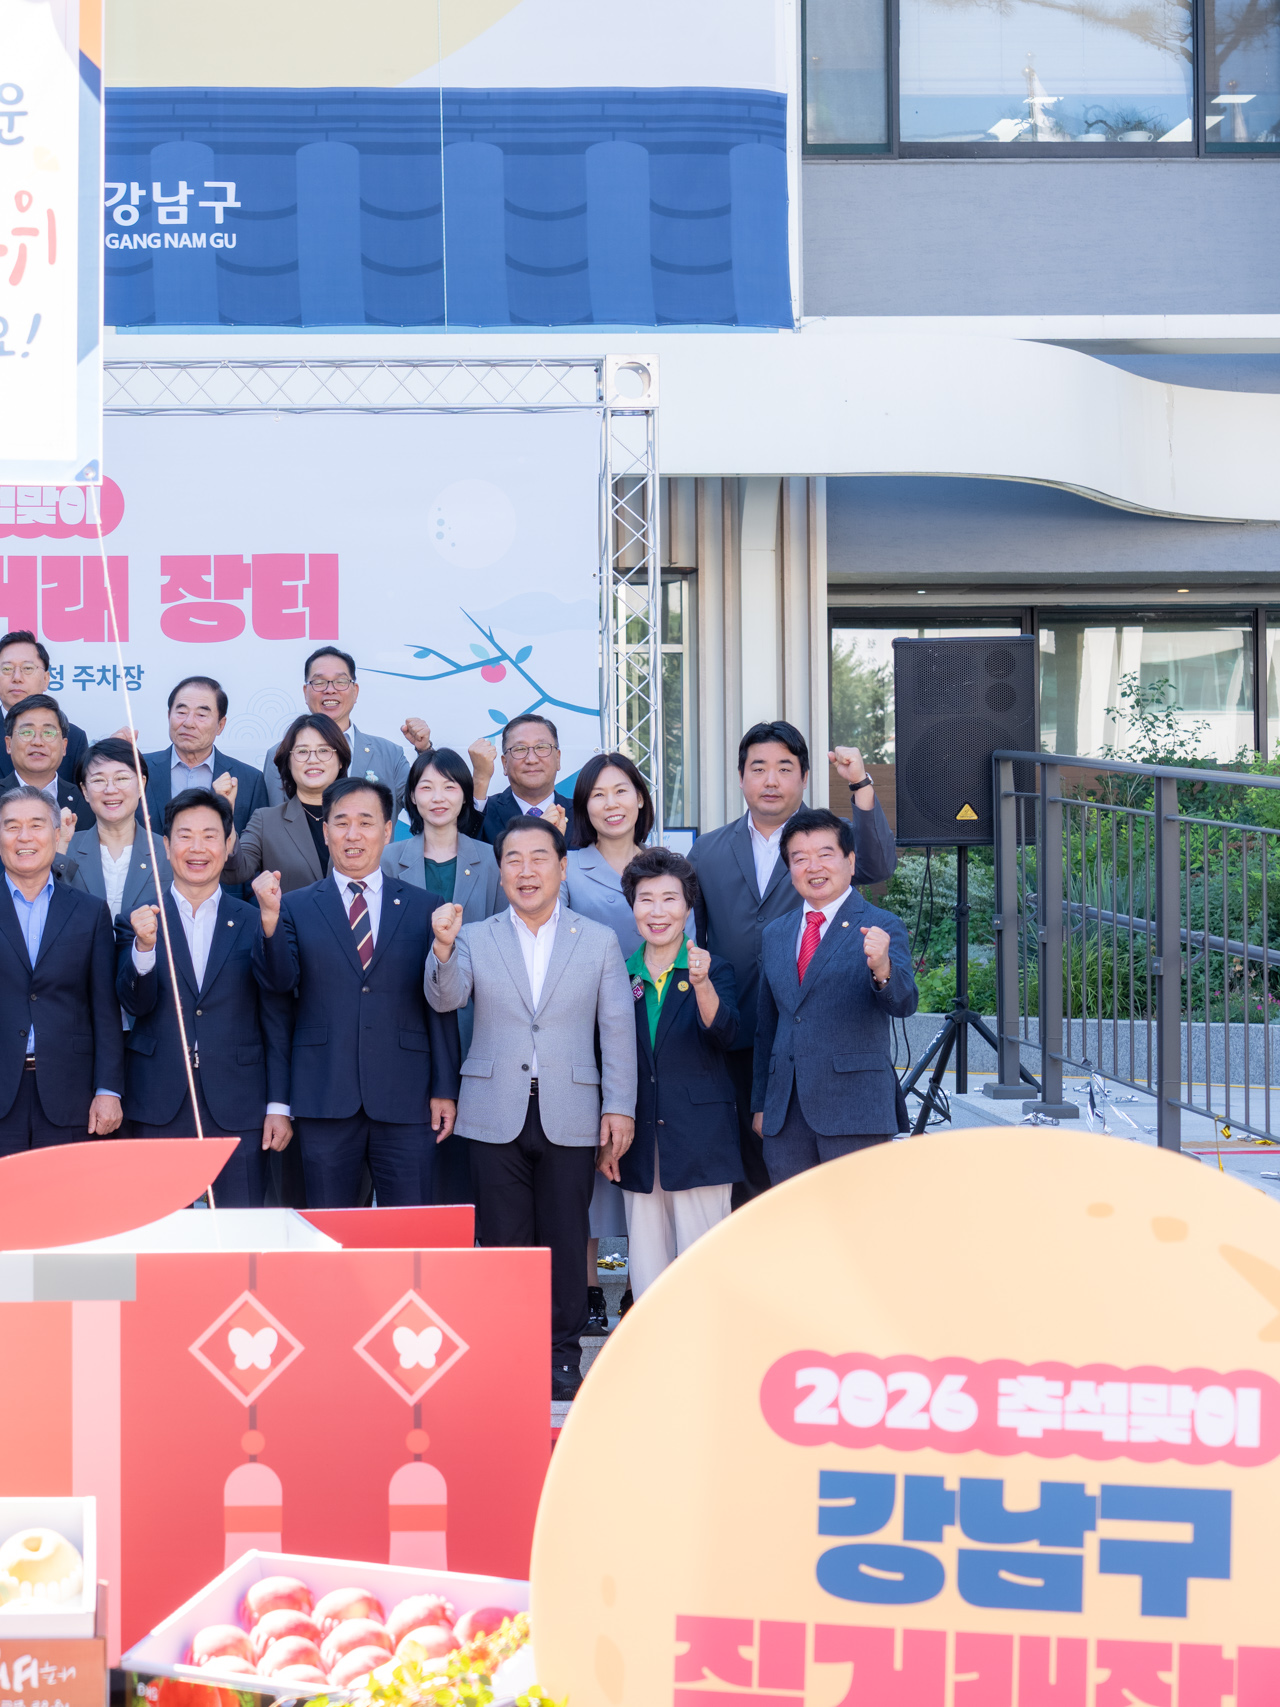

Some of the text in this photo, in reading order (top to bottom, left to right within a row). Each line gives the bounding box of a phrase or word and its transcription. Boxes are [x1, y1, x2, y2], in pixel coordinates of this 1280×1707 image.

[105, 181, 241, 226] 강남구
[105, 233, 237, 249] GANG NAM GU
[160, 553, 339, 643] 장터
[72, 664, 144, 691] 주차장
[794, 1367, 1261, 1449] 2026 추석맞이
[816, 1469, 1232, 1619] 강남구
